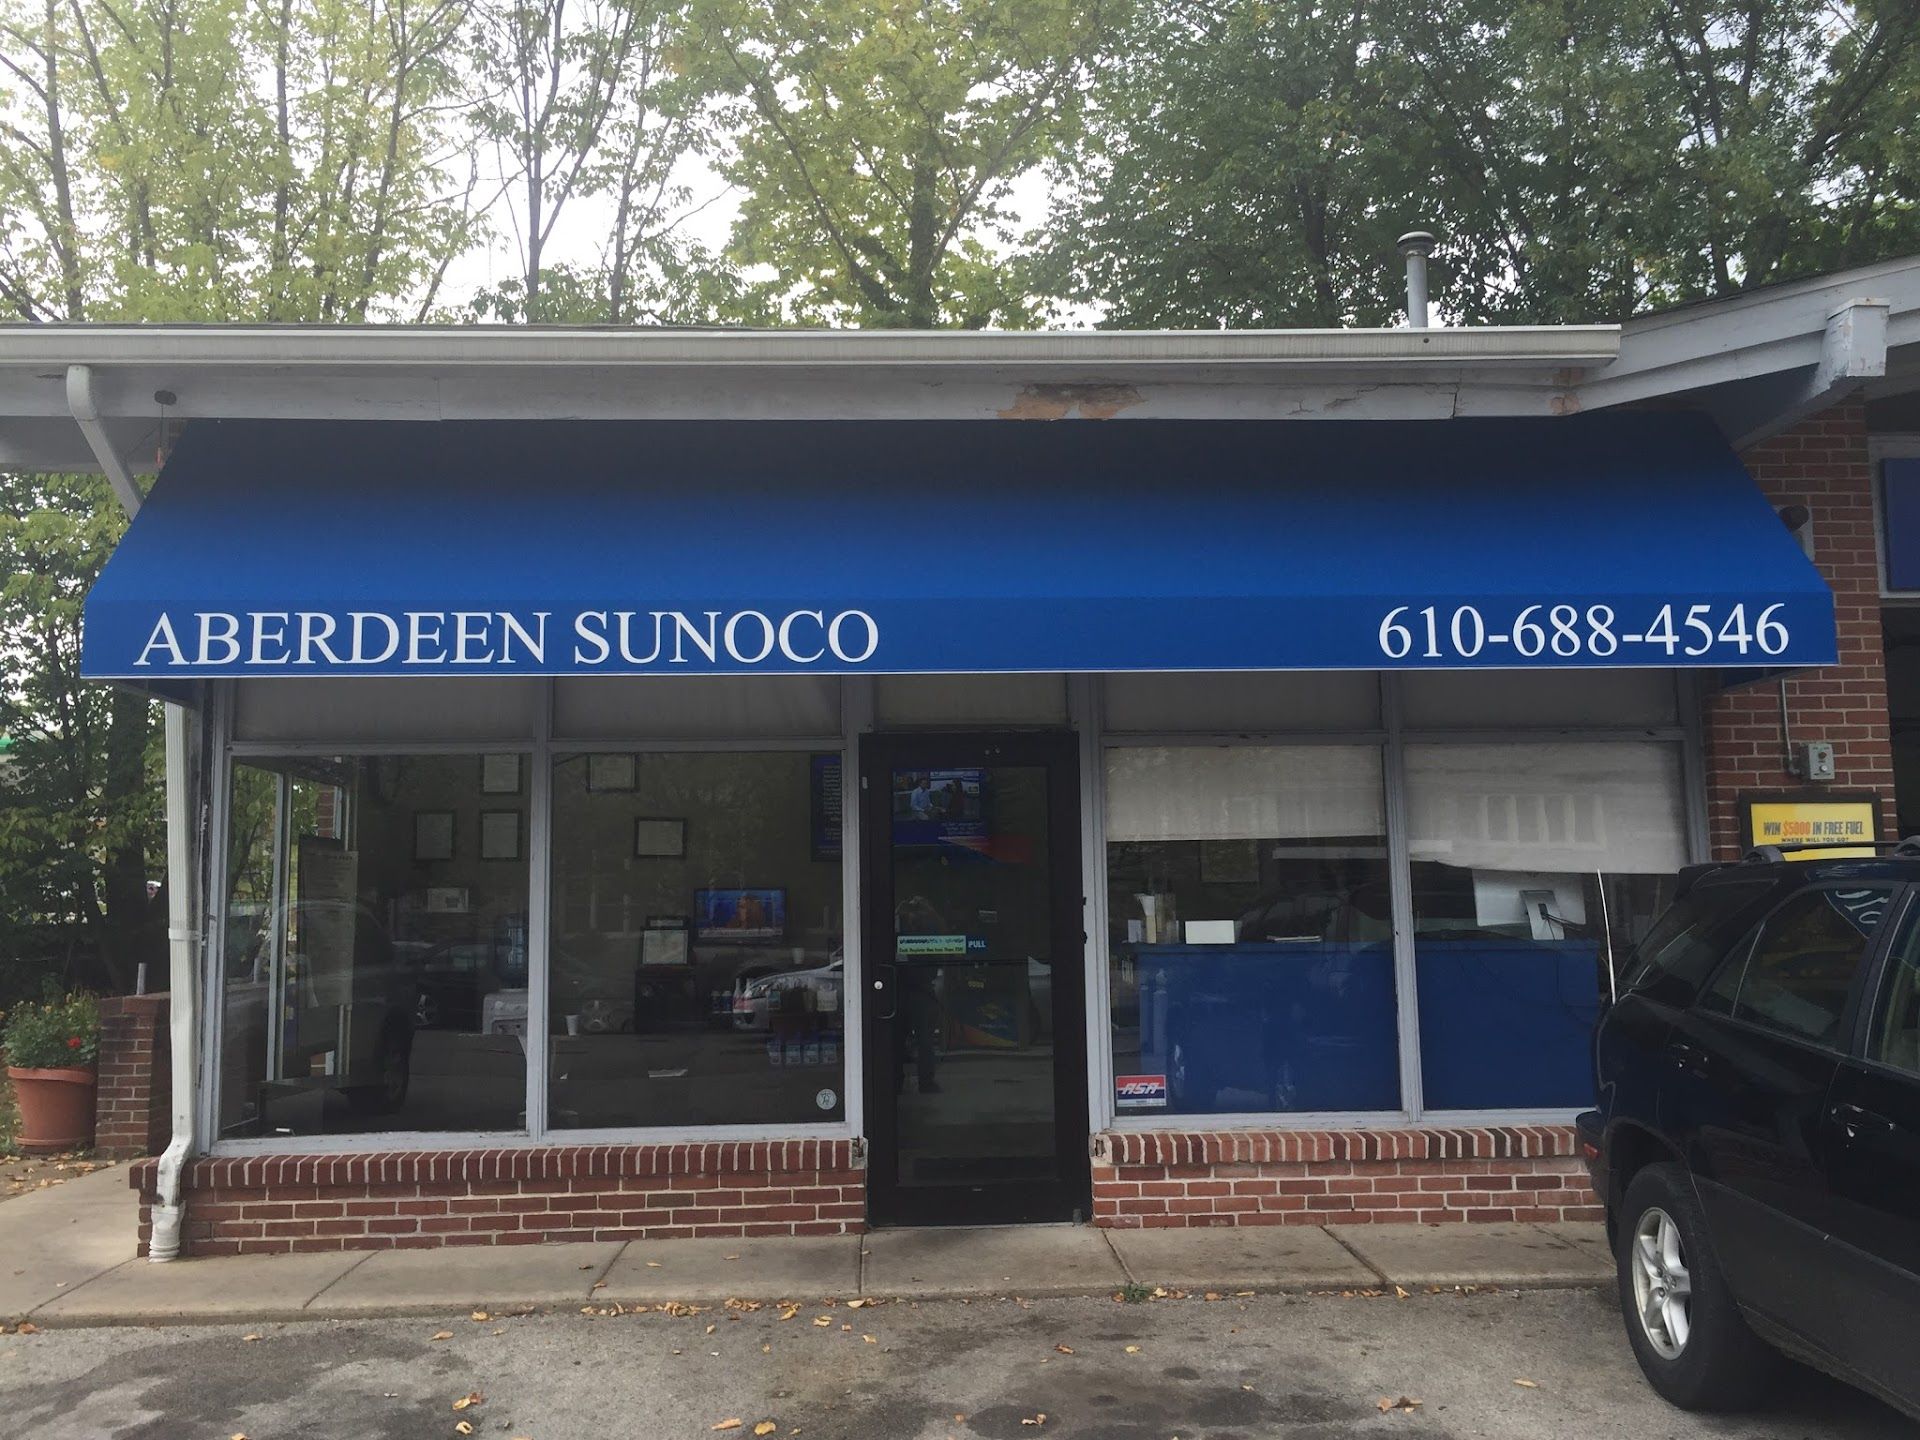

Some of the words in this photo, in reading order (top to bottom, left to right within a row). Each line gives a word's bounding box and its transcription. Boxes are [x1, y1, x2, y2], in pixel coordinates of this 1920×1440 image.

[132, 611, 552, 666] ABERDEEN
[574, 610, 879, 665] SUNOCO
[1378, 603, 1790, 659] 610-688-4546
[1763, 822, 1781, 835] WIN
[1782, 820, 1811, 836] $5000
[1812, 822, 1822, 835] IN
[1823, 821, 1844, 835] FREE
[1845, 821, 1864, 835] FUEL
[968, 940, 986, 948] PULL
